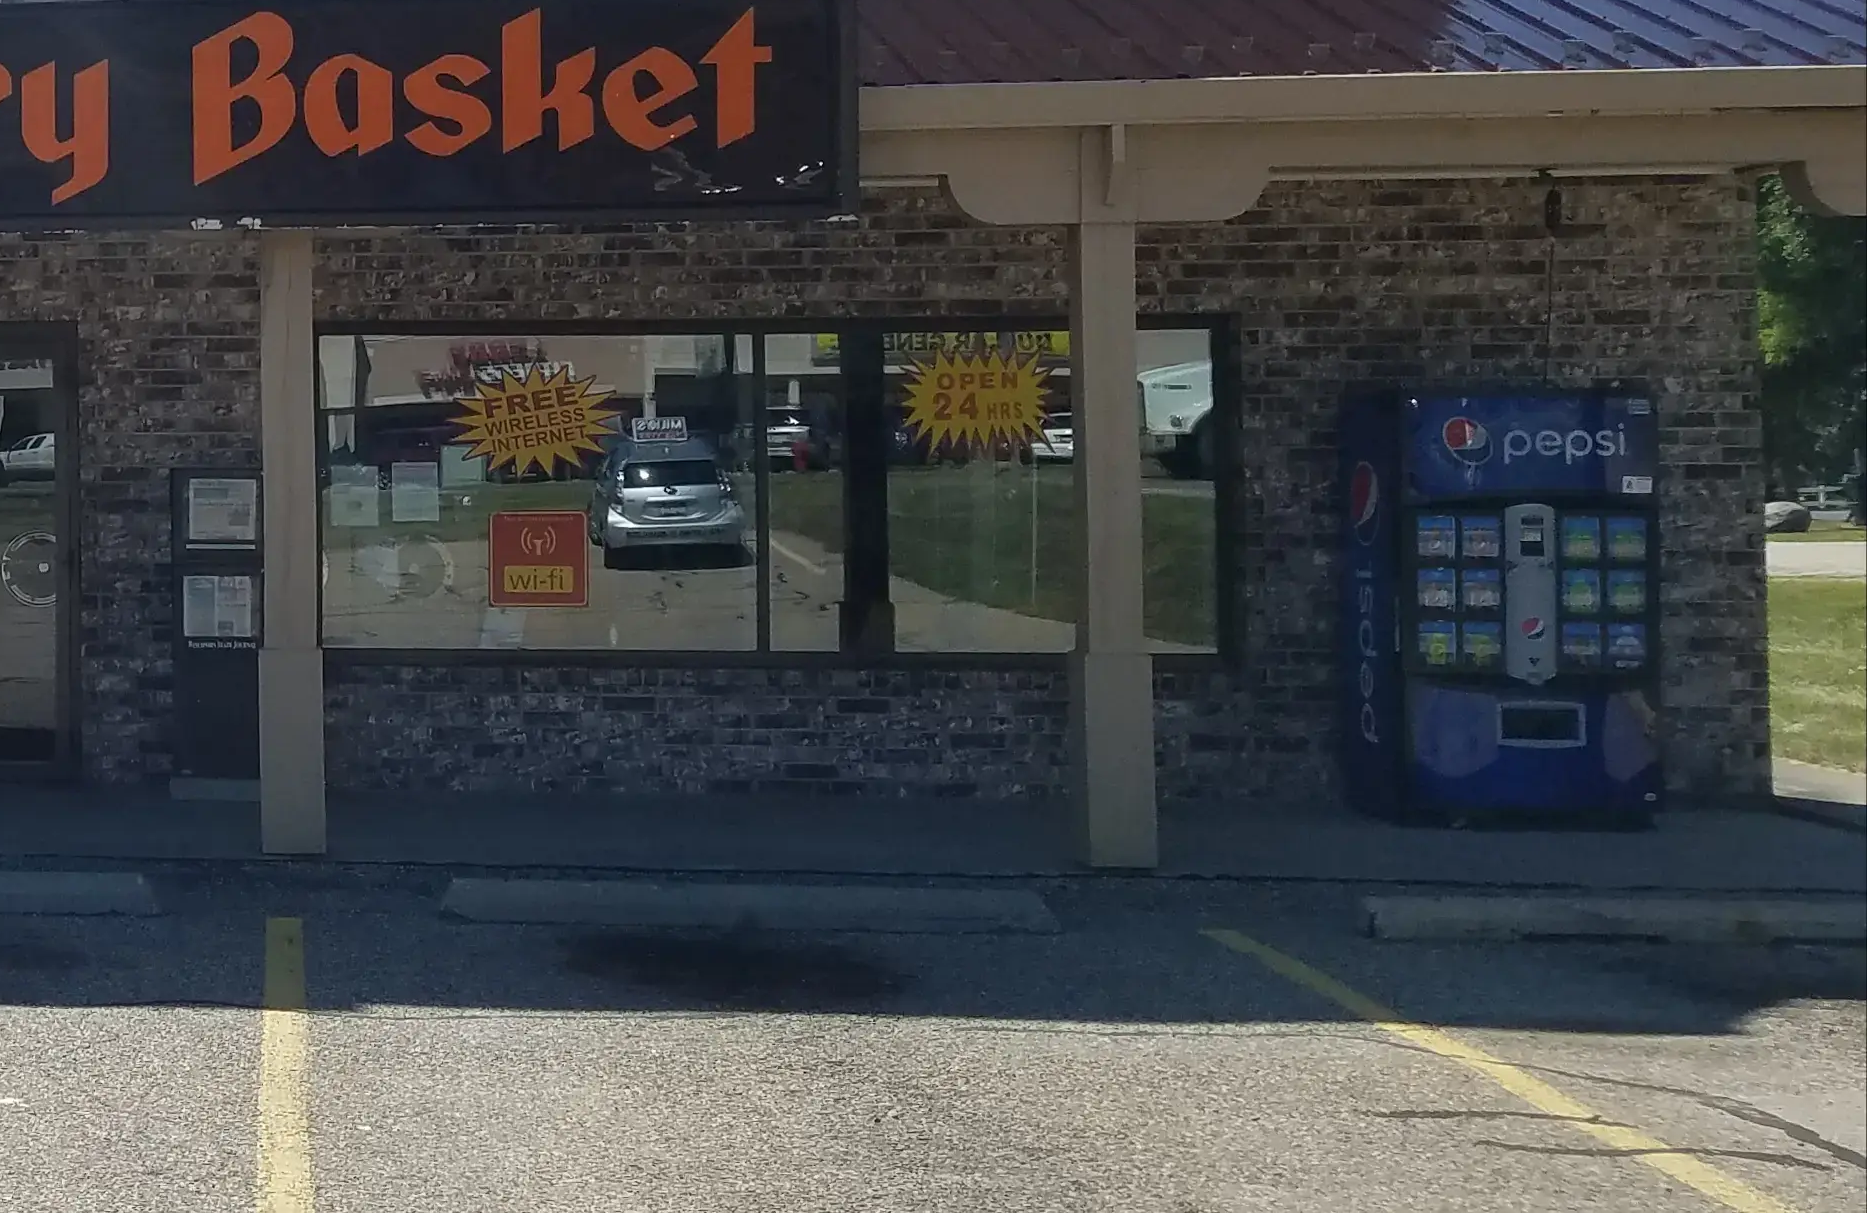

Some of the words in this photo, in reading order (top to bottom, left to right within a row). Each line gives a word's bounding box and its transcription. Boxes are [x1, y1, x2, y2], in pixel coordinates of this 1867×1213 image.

[192, 8, 773, 185] Basket
[936, 372, 1018, 390] OPEN
[483, 386, 579, 419] FREE
[932, 392, 979, 420] 24
[987, 401, 1023, 420] HRS
[484, 407, 585, 437] WIRELESS
[491, 425, 587, 454] INTERNET
[1502, 422, 1626, 466] pepsi
[508, 568, 564, 590] wi-fi
